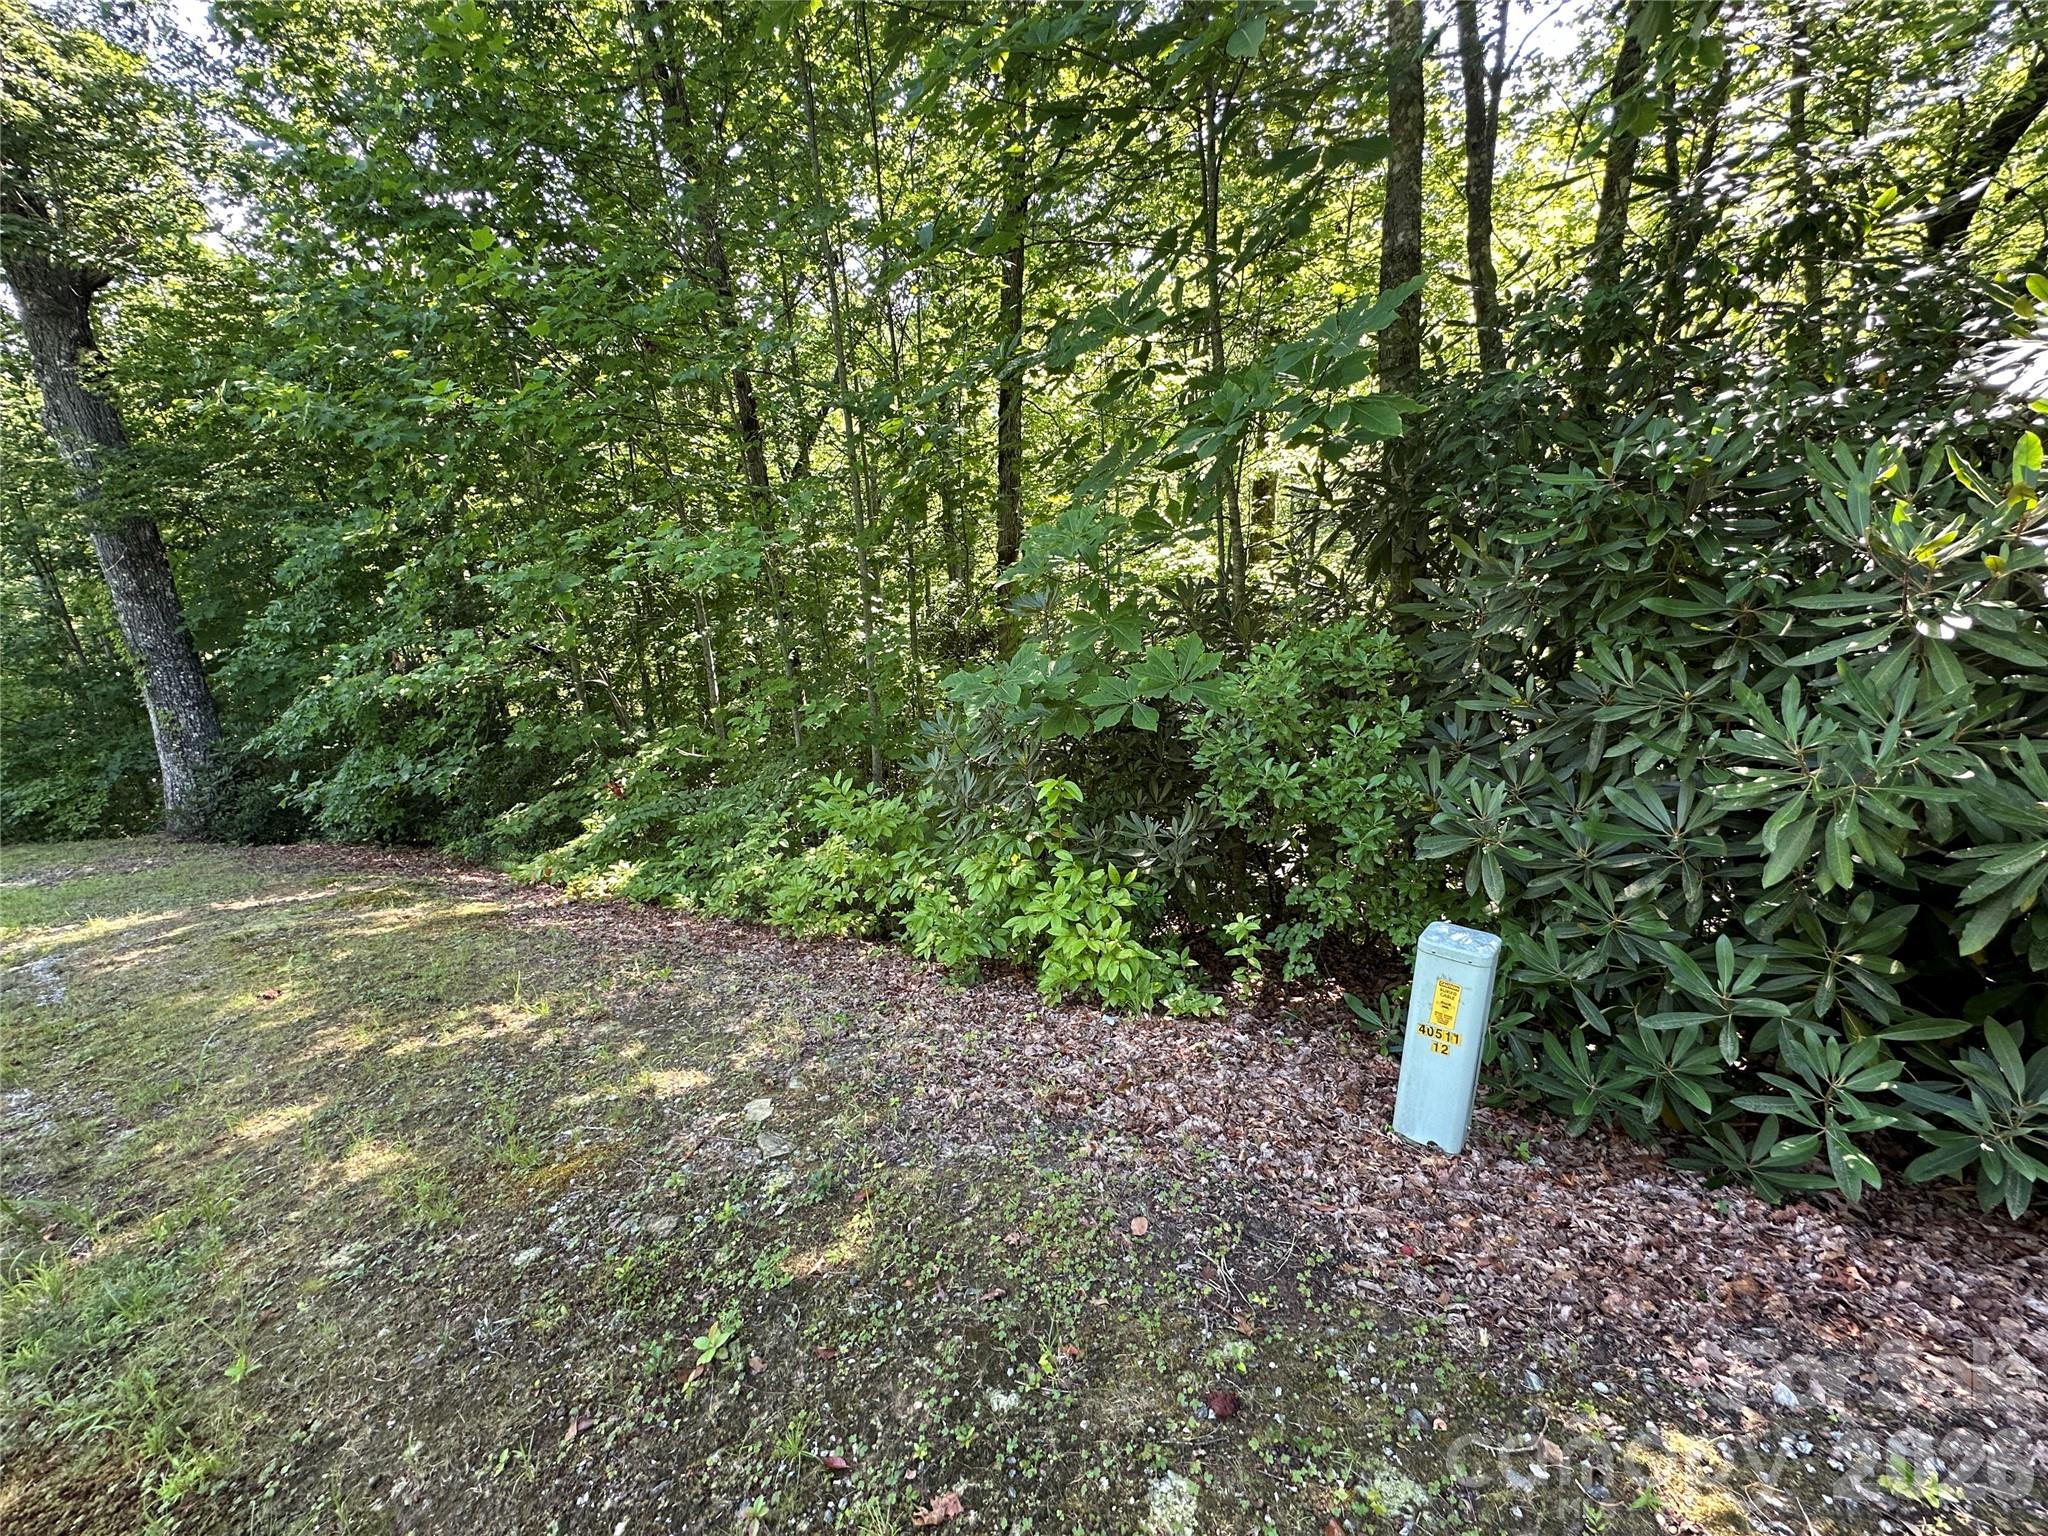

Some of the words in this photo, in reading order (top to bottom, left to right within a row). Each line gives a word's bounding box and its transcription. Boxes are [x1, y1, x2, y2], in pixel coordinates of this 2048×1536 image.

[1439, 992, 1455, 1001] CABLE
[1418, 1024, 1460, 1045] 40511
[1433, 1042, 1449, 1056] 12
